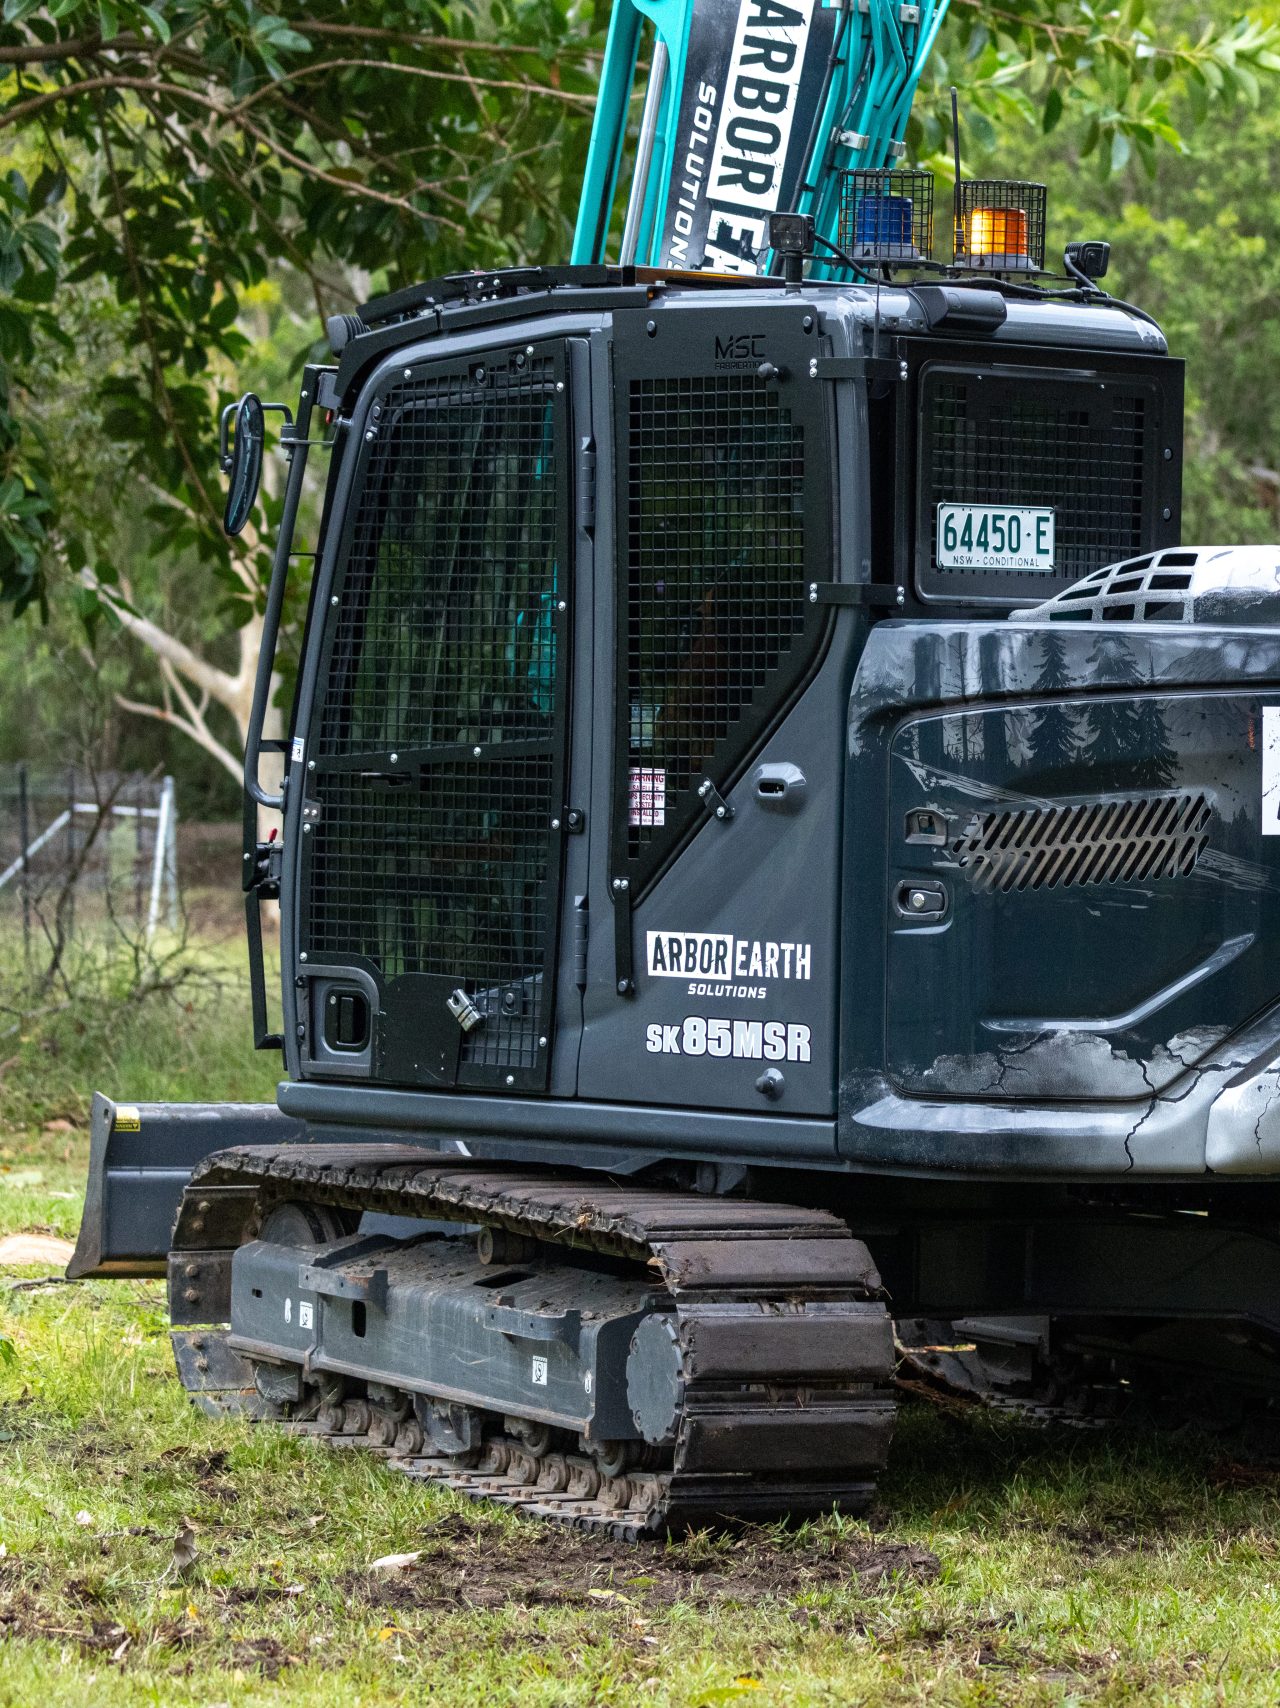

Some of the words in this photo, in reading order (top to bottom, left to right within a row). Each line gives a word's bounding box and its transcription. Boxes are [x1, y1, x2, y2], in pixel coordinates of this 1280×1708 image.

[716, 0, 804, 195] ARBOR
[715, 334, 766, 359] MSC
[953, 555, 973, 564] NSW
[982, 556, 1040, 567] CONDITIONAL
[653, 935, 728, 975] ARBOR
[735, 940, 811, 980] EARTH
[688, 983, 767, 999] SOLUTIONS
